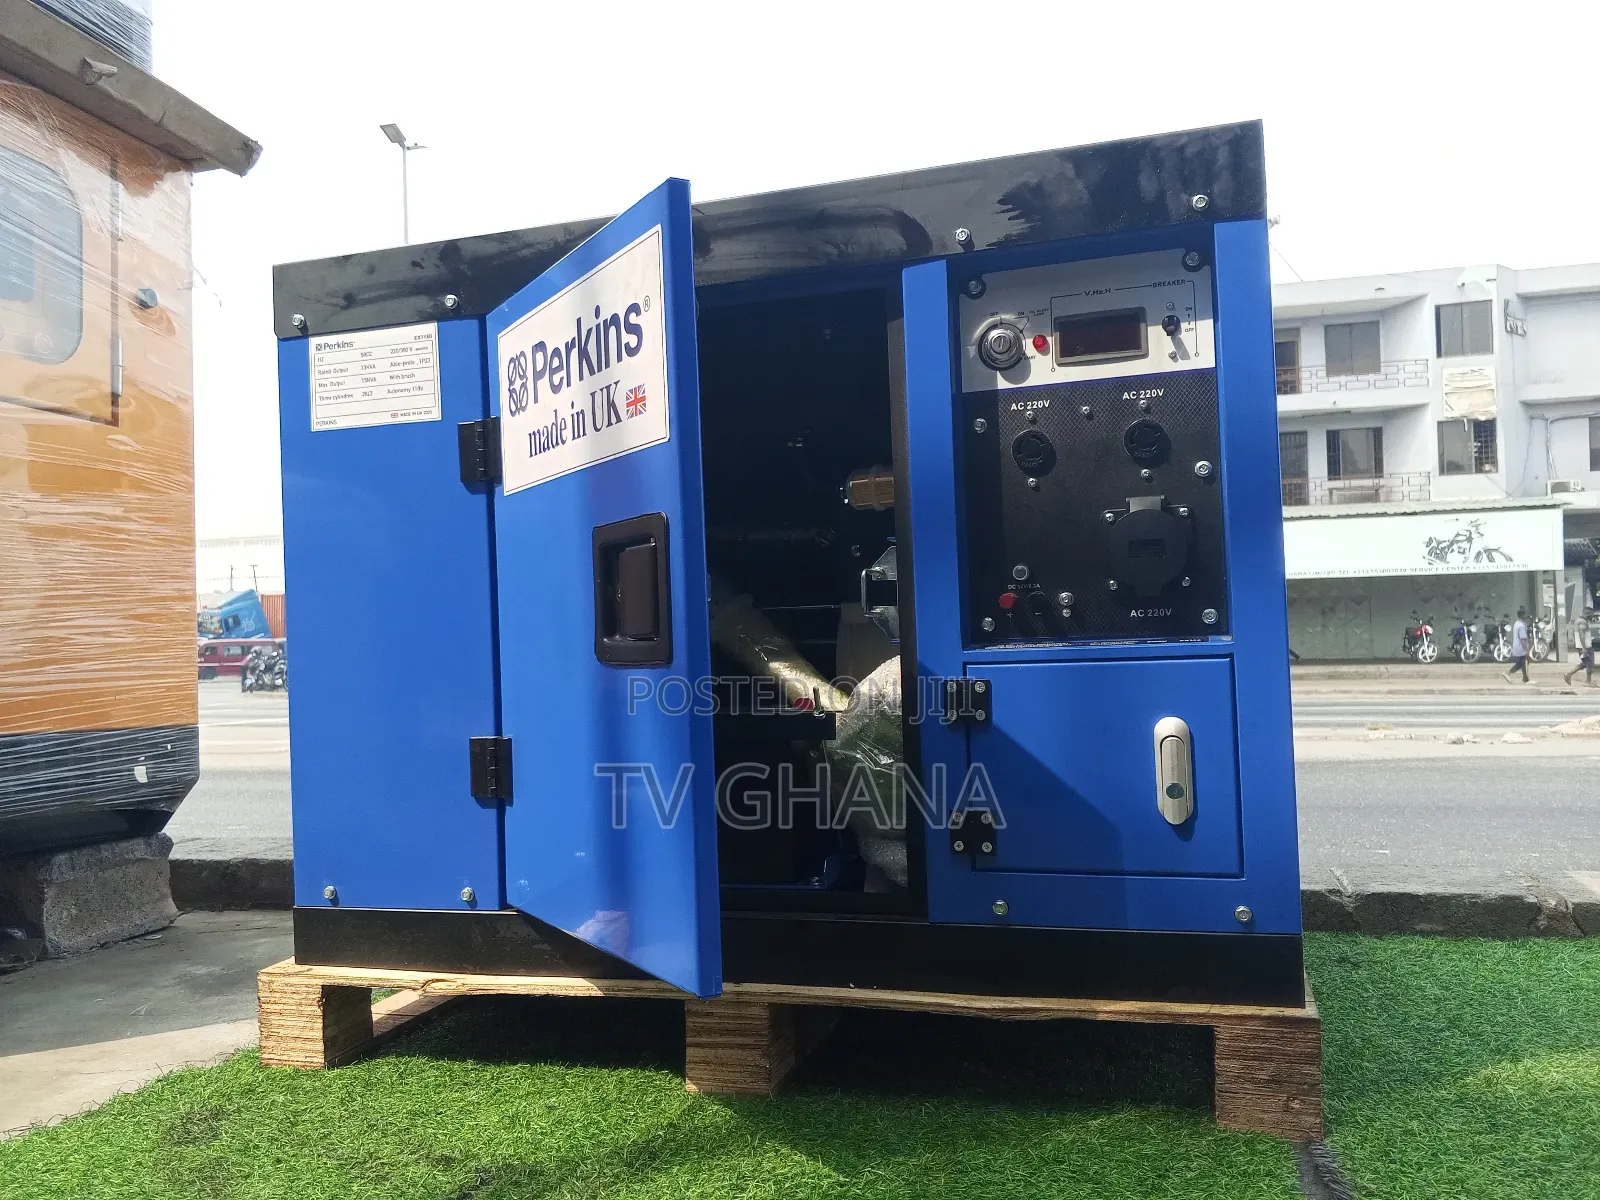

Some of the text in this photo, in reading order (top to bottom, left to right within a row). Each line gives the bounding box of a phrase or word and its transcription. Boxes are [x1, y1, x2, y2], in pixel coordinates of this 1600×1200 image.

[1152, 279, 1187, 288] BREAKER
[323, 341, 355, 351] Perkins
[333, 367, 349, 375] Output
[330, 380, 346, 388] Output
[1122, 388, 1165, 400] AC 220V
[1010, 399, 1050, 411] AC 220V
[529, 380, 623, 458] made in UK
[1130, 608, 1173, 618] AC 220V
